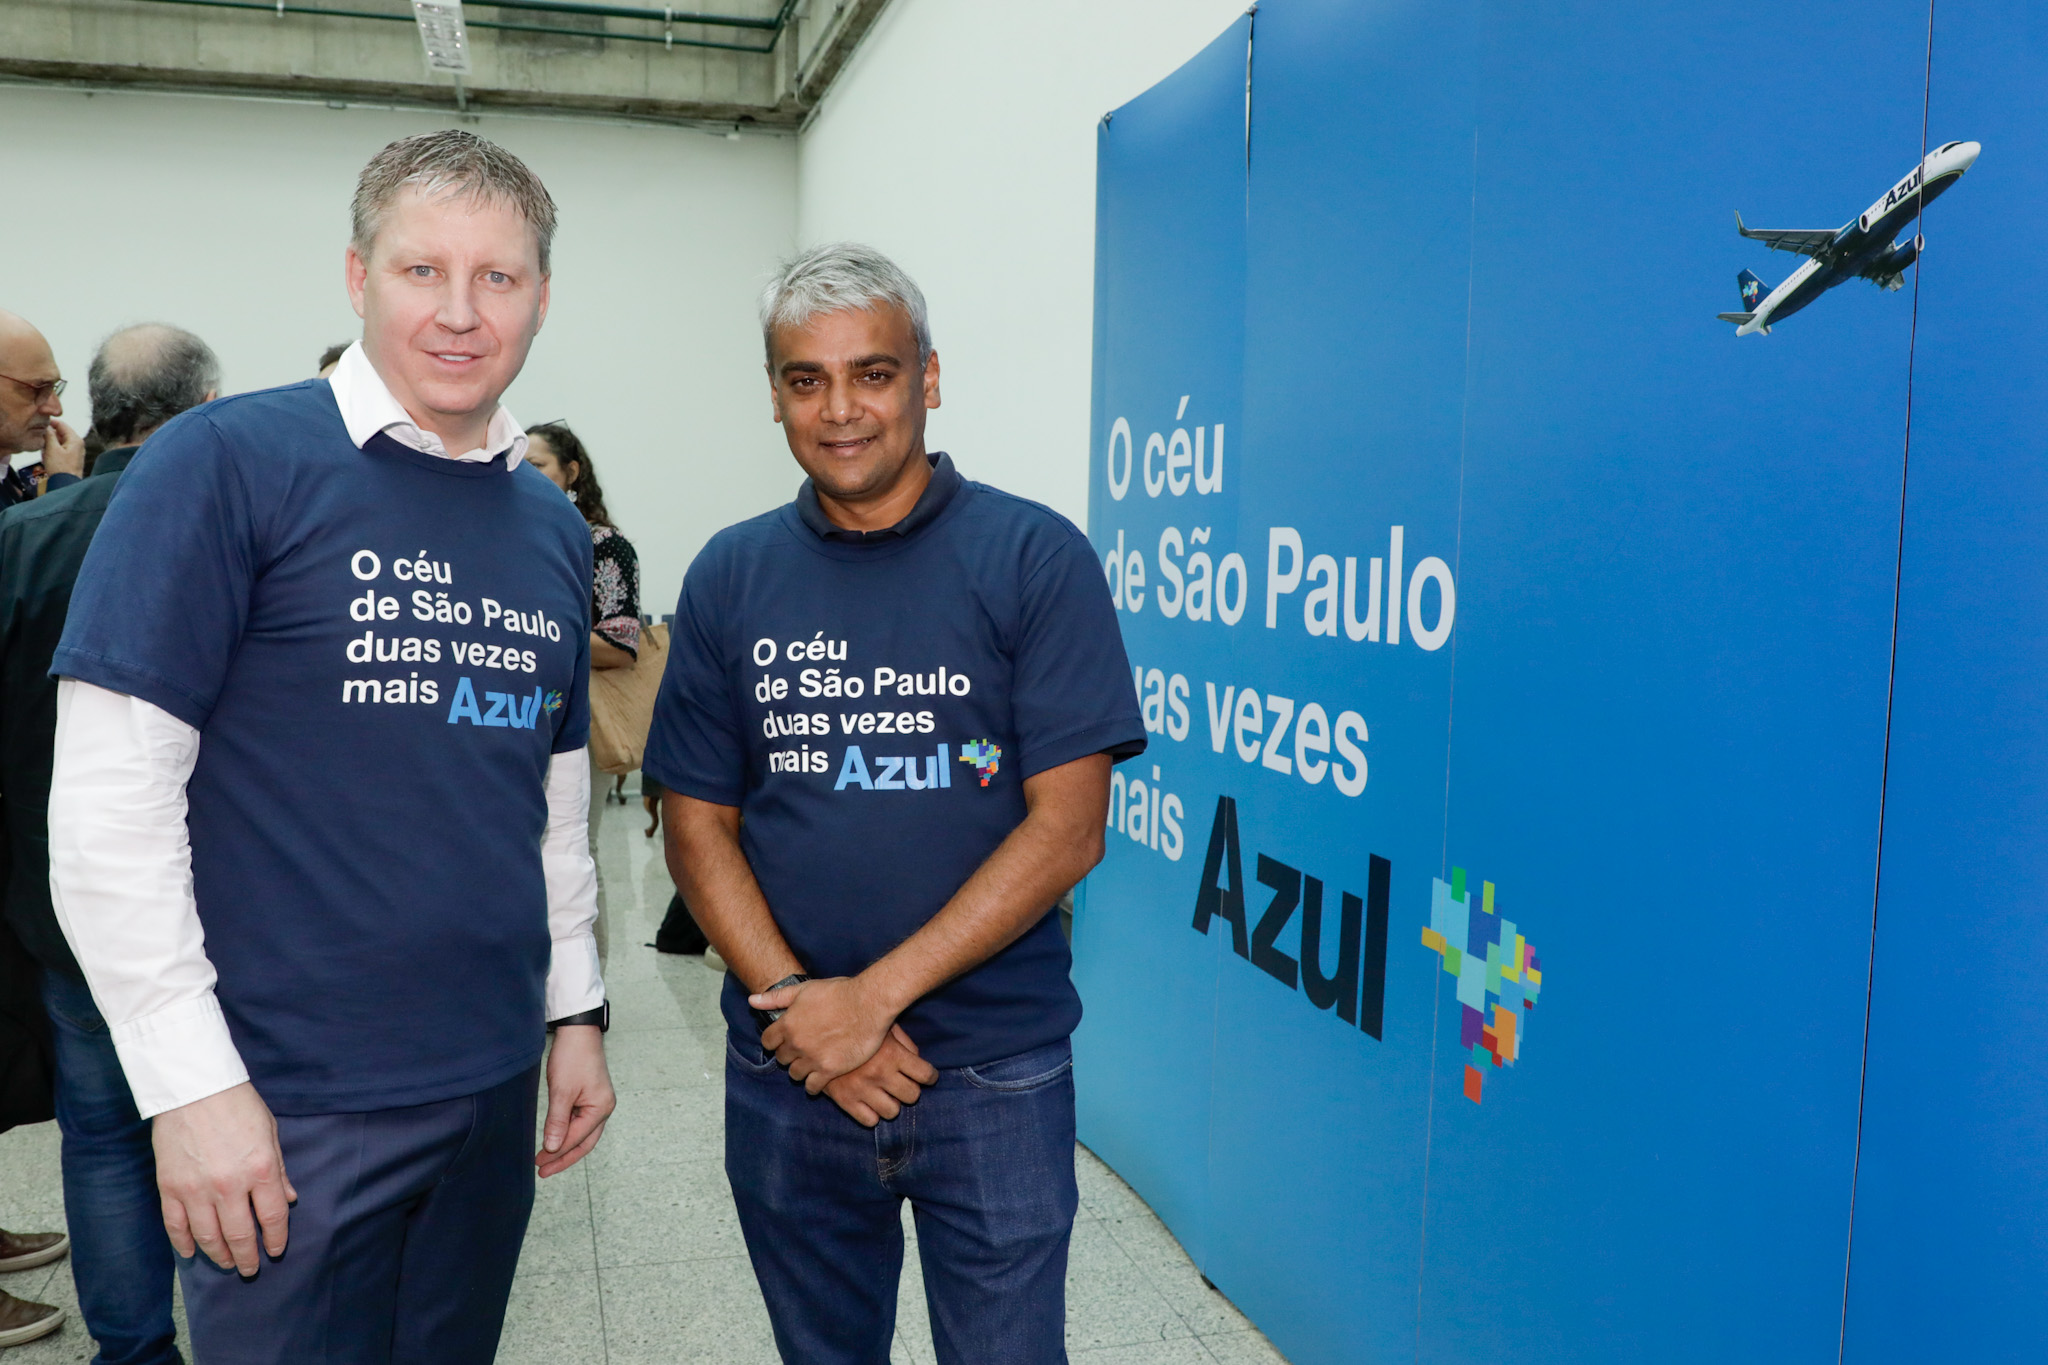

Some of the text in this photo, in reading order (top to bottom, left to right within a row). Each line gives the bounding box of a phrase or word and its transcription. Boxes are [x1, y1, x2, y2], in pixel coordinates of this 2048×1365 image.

[1884, 165, 1922, 212] Azul
[1107, 395, 1224, 501] O céu
[351, 549, 452, 584] O céu
[1104, 525, 1456, 651] de São Paulo
[349, 589, 561, 643] de São Paulo
[346, 631, 537, 673] duas vezes
[753, 631, 847, 666] O céu
[342, 672, 542, 730] mais Azul
[755, 666, 971, 703] de São Paulo
[763, 710, 935, 739] duas vezes
[1135, 665, 1369, 797] as vezes
[769, 743, 951, 791] mais Azul
[1192, 795, 1391, 1042] Azul
